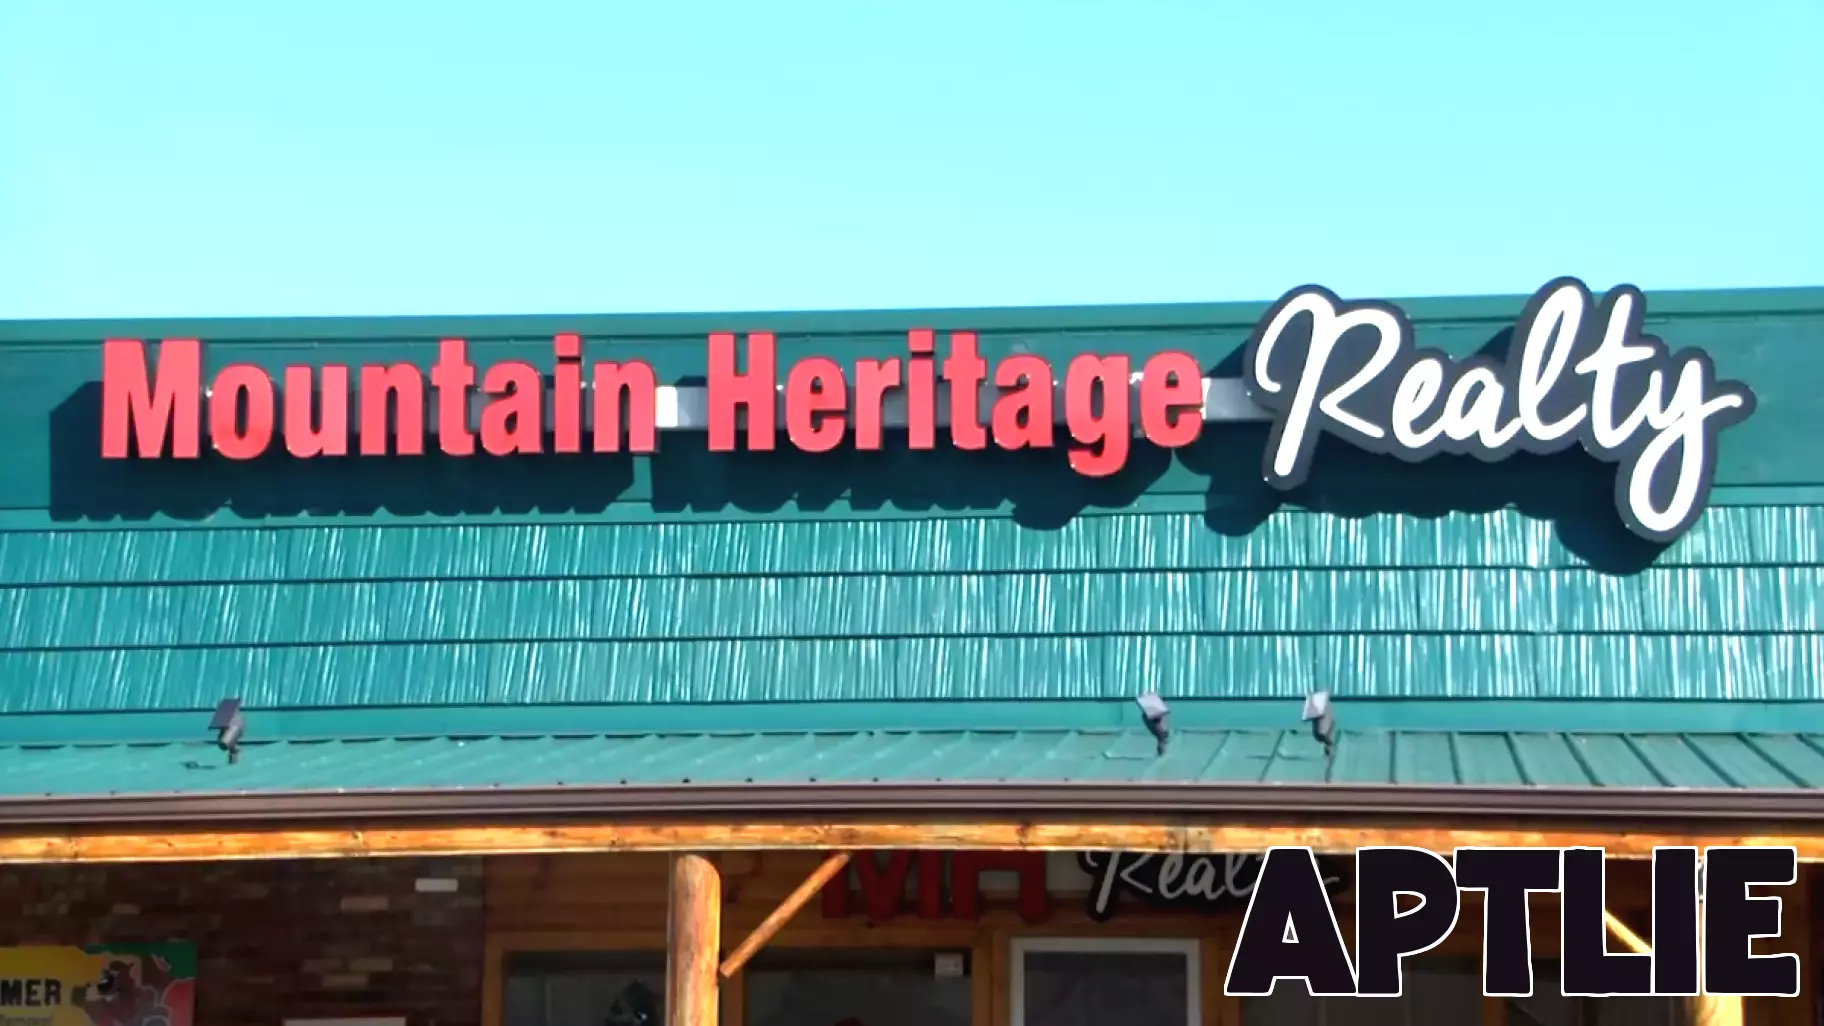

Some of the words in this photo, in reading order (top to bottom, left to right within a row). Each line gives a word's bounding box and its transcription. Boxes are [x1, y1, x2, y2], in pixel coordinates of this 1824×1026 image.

[101, 333, 658, 459] Mountain
[706, 328, 1203, 478] Heritage
[1254, 285, 1742, 532] Realty
[1083, 852, 1340, 912] Real
[0, 978, 61, 1006] MER
